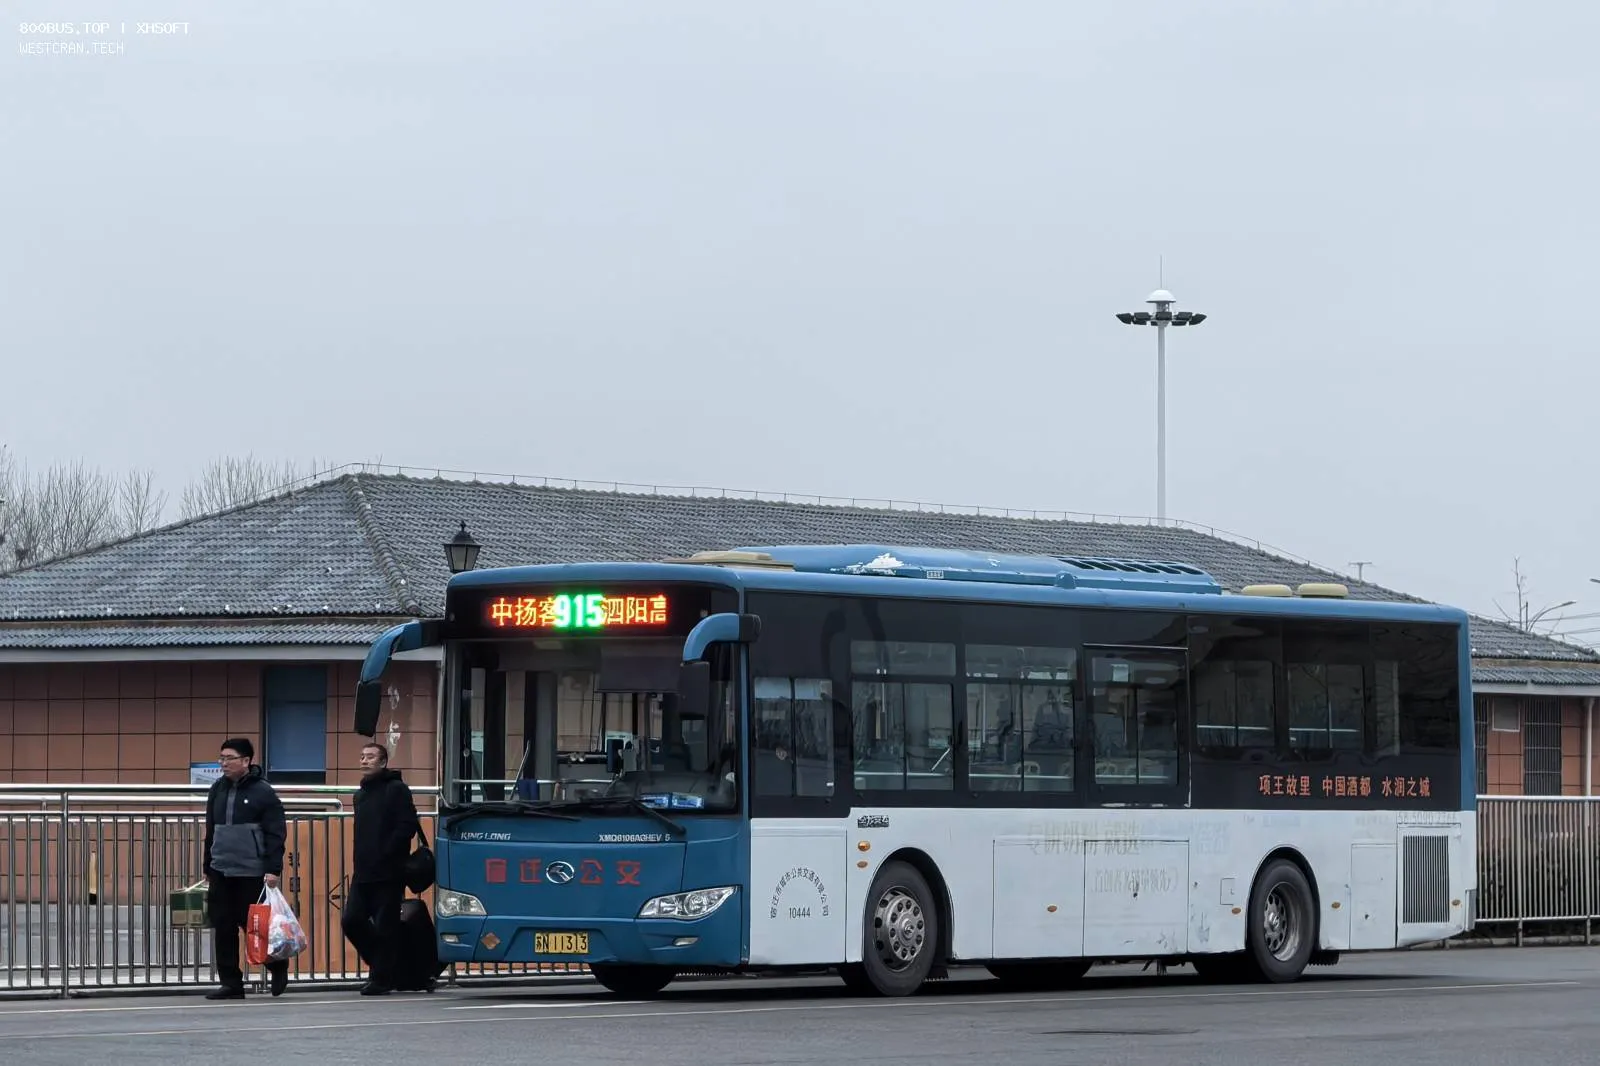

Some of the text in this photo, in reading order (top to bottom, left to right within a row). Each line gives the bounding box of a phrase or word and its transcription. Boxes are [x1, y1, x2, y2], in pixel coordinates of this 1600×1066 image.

[554, 594, 604, 627] 915
[1259, 774, 1431, 797] 项王故里 中国酒都 水润之城
[485, 832, 511, 841] LONG
[788, 907, 811, 919] 10444
